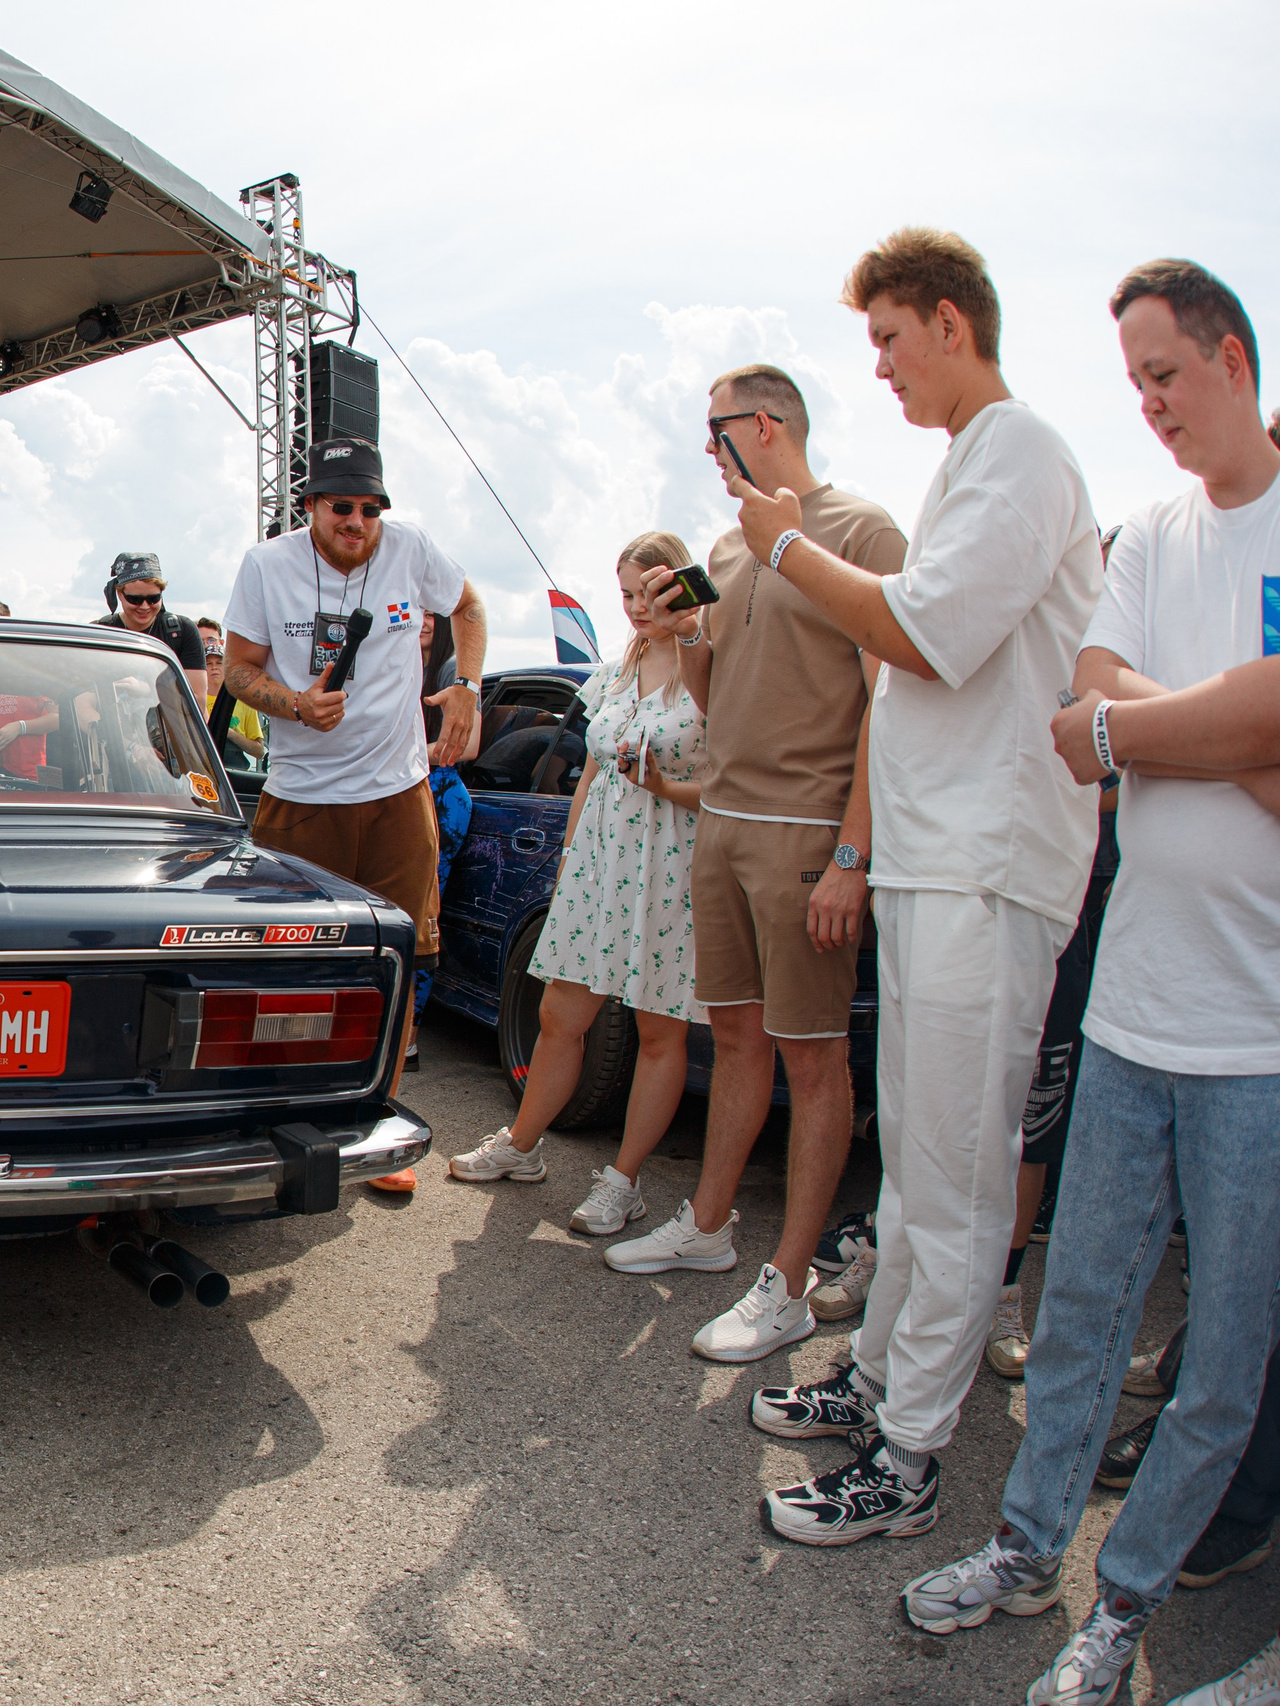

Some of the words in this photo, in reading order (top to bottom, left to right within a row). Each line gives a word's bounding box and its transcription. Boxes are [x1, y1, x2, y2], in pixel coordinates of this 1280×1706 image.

[196, 783, 214, 797] 66
[268, 927, 310, 941] 1700
[316, 927, 341, 940] LS
